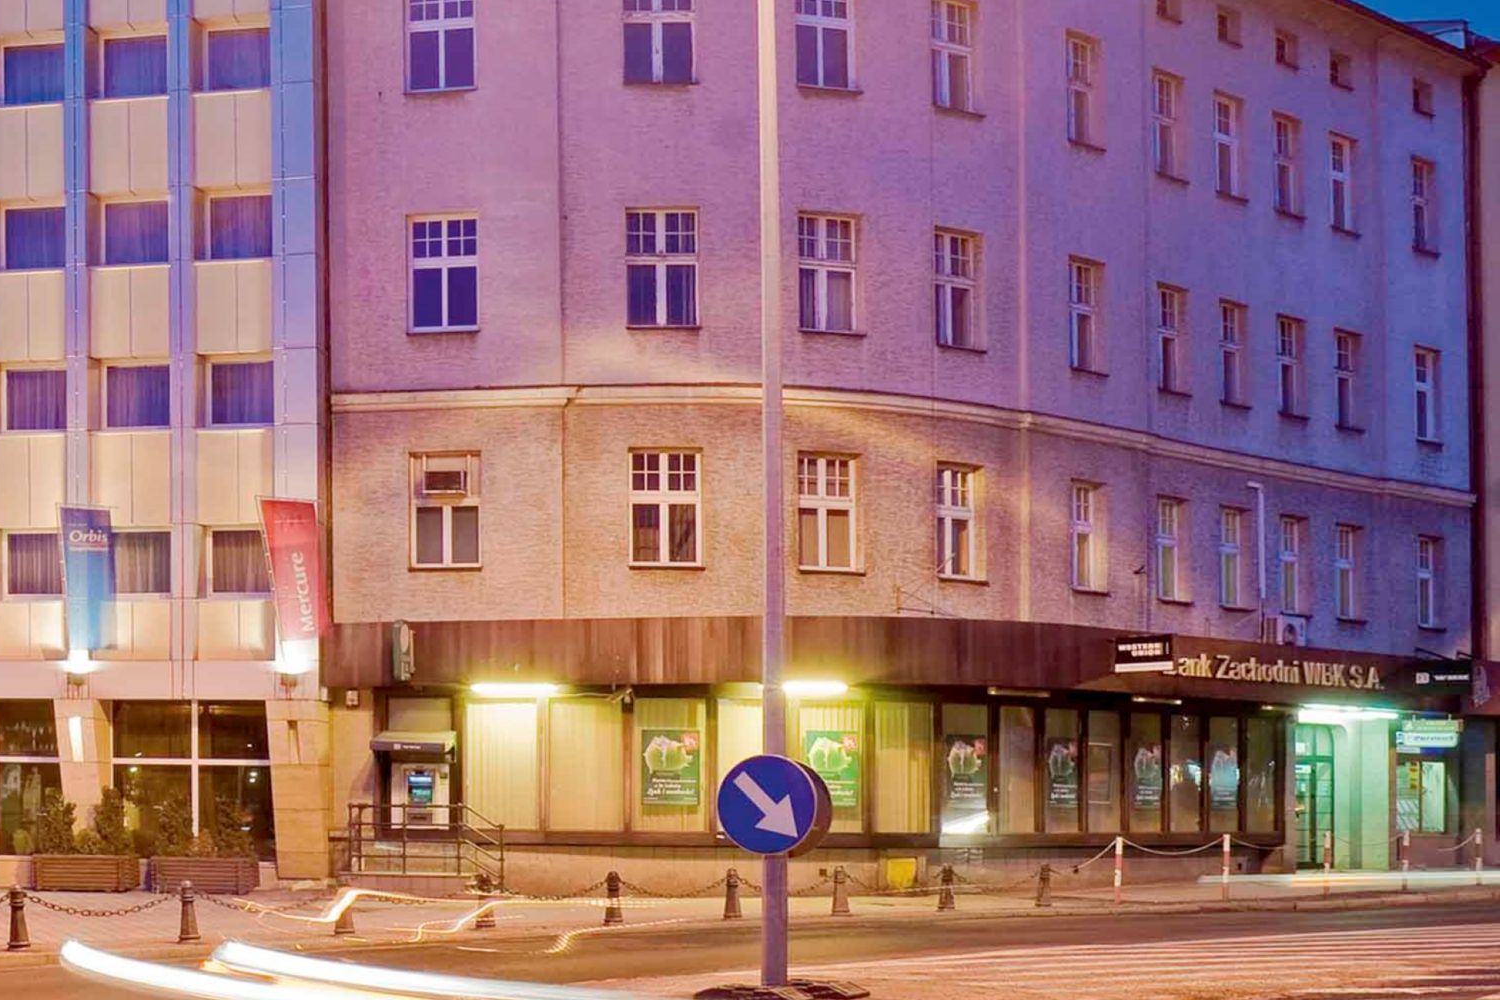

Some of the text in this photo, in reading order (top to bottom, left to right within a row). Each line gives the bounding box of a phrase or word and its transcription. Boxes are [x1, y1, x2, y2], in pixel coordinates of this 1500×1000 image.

[69, 529, 108, 543] Orbis
[1163, 653, 1213, 678] ank
[1215, 654, 1300, 684] Zachodni
[1303, 660, 1349, 687] WBK
